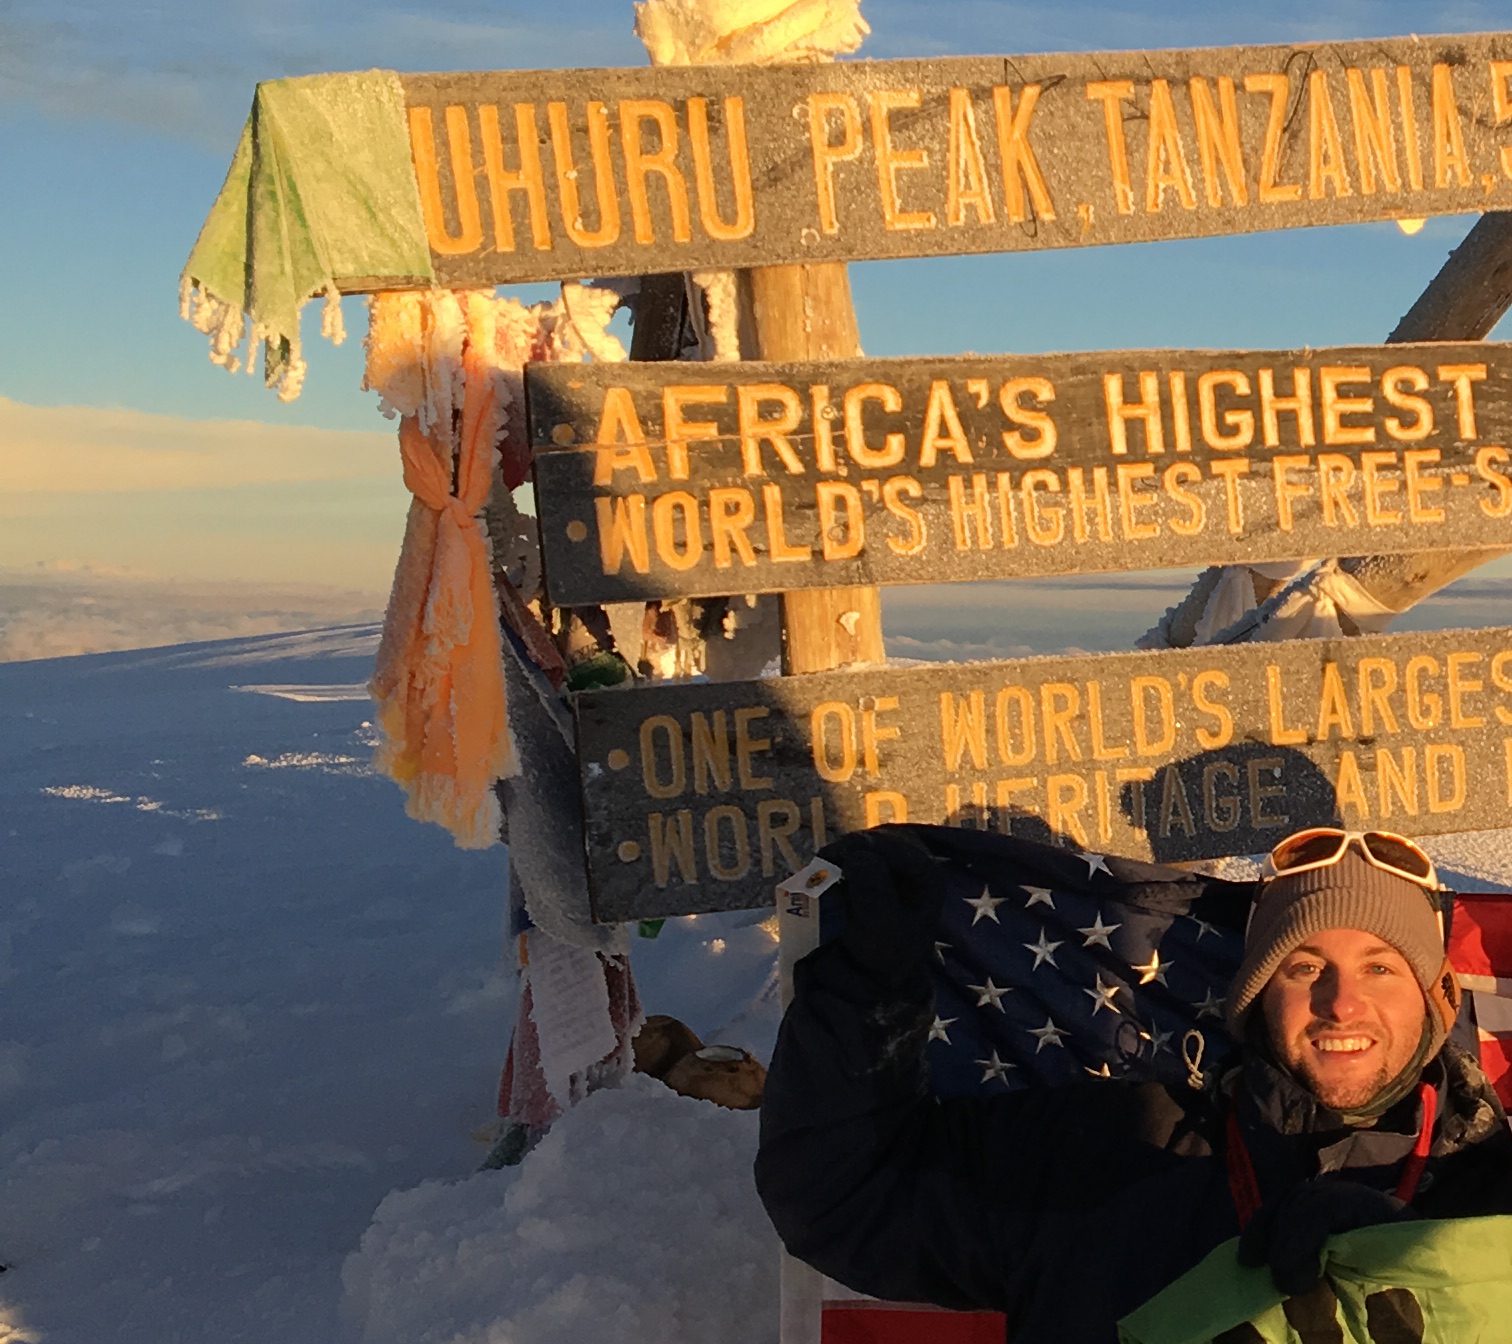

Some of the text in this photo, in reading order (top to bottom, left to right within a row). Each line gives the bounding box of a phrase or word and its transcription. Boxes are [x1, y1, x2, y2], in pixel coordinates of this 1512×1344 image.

[409, 96, 754, 256] UHURU
[594, 375, 1058, 485] AFRICA'S
[1104, 362, 1489, 455] HIGHEST
[594, 474, 924, 577] WORLD'S
[947, 457, 1251, 553] HIGHEST
[641, 706, 772, 799] ONE
[811, 693, 902, 783] OF
[940, 669, 1235, 773] WORLD'S
[944, 755, 1288, 846] HERITAGE
[1335, 742, 1468, 820] AND
